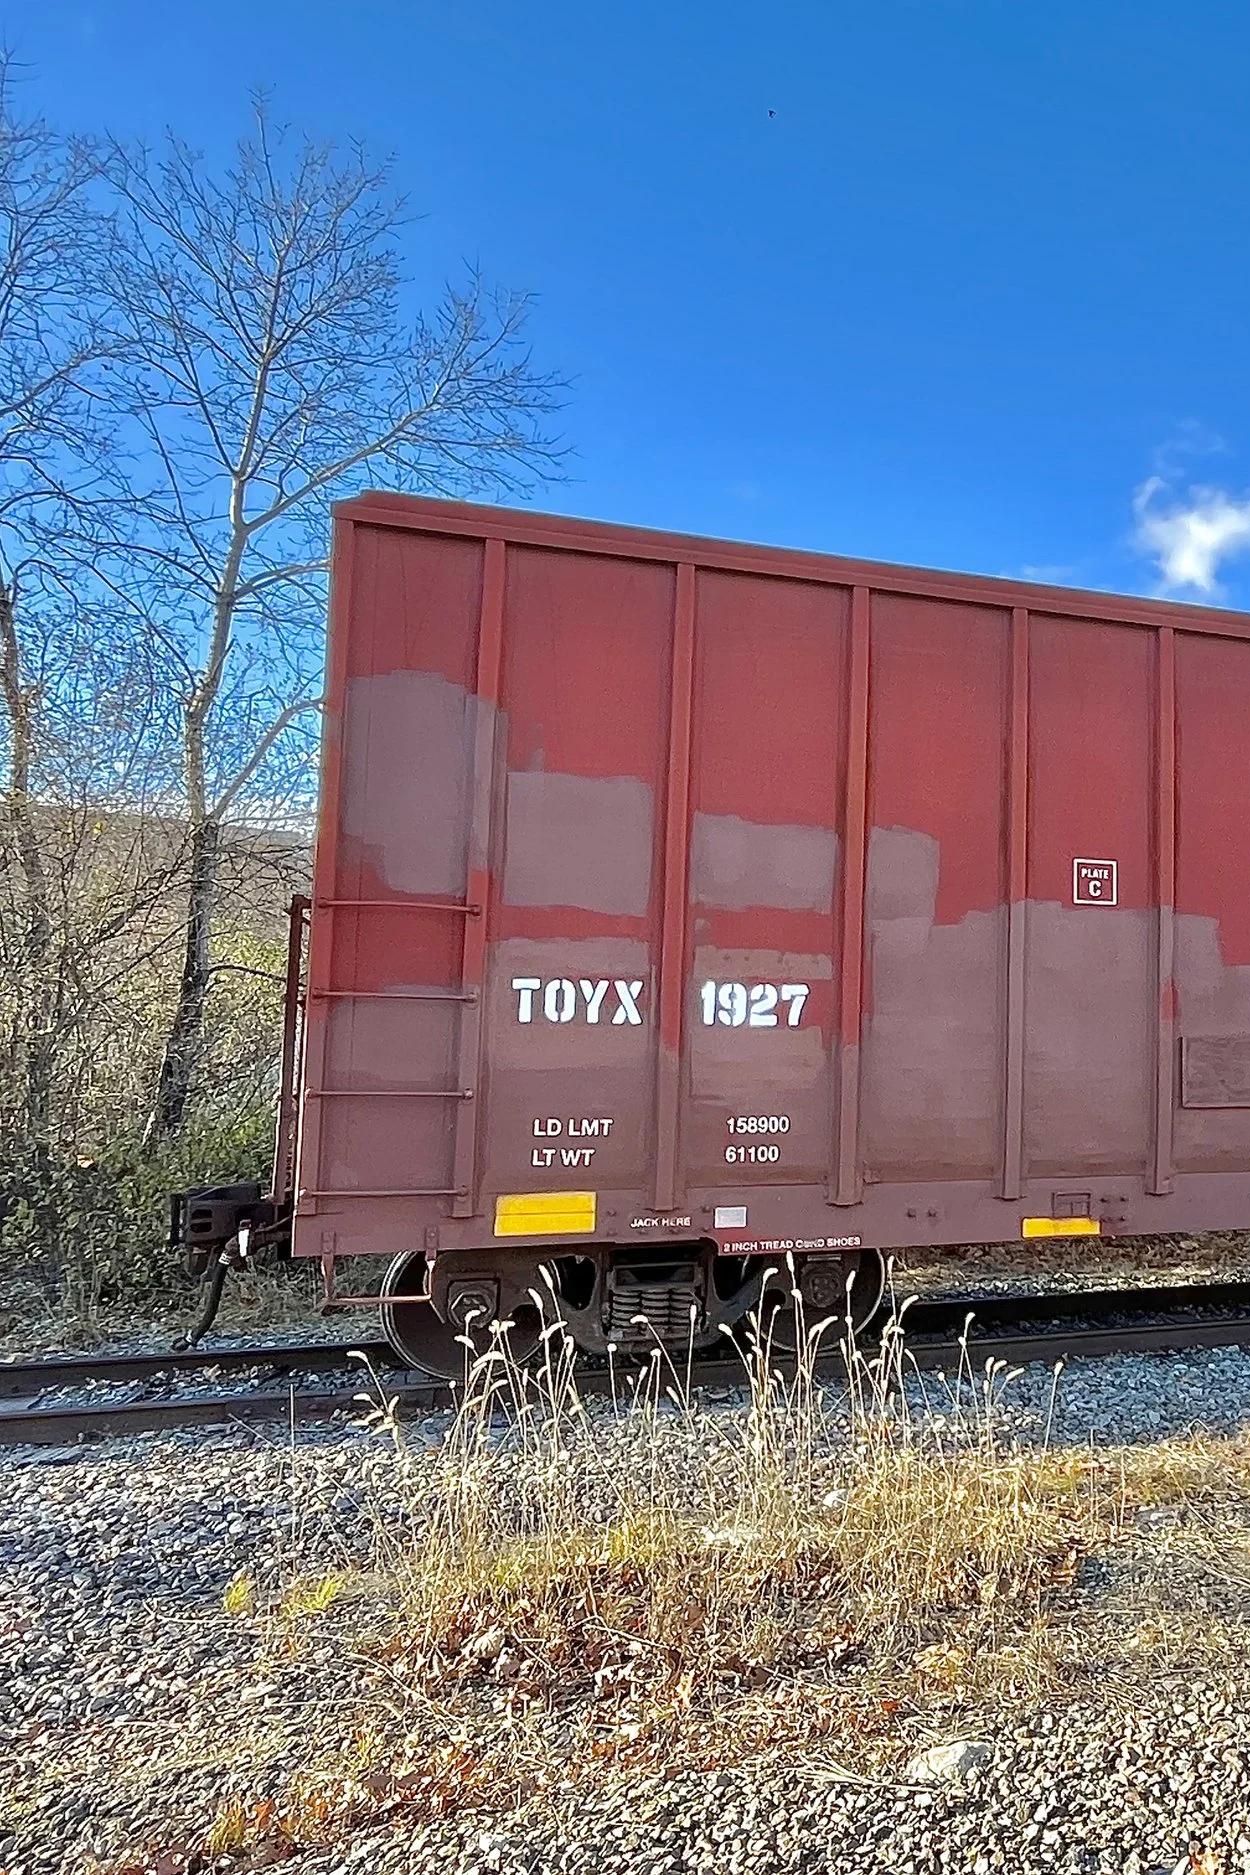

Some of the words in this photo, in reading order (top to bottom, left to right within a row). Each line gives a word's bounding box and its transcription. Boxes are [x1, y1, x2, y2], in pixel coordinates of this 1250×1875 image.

[1081, 867, 1109, 880] PLATE
[1089, 880, 1102, 897] C
[512, 977, 643, 1024] TOYX
[700, 980, 809, 1027] 1927
[533, 1118, 562, 1137] LD
[568, 1118, 613, 1136] LMT
[727, 1116, 790, 1134] 158900
[531, 1149, 556, 1167] LT
[560, 1149, 595, 1167] WT
[725, 1145, 780, 1163] 61100
[630, 1217, 660, 1228] JACK
[661, 1216, 691, 1227] HERE
[723, 1242, 731, 1252] 2
[731, 1241, 758, 1252] INCH
[759, 1240, 794, 1250] TREAD
[826, 1236, 861, 1247] SHOES
